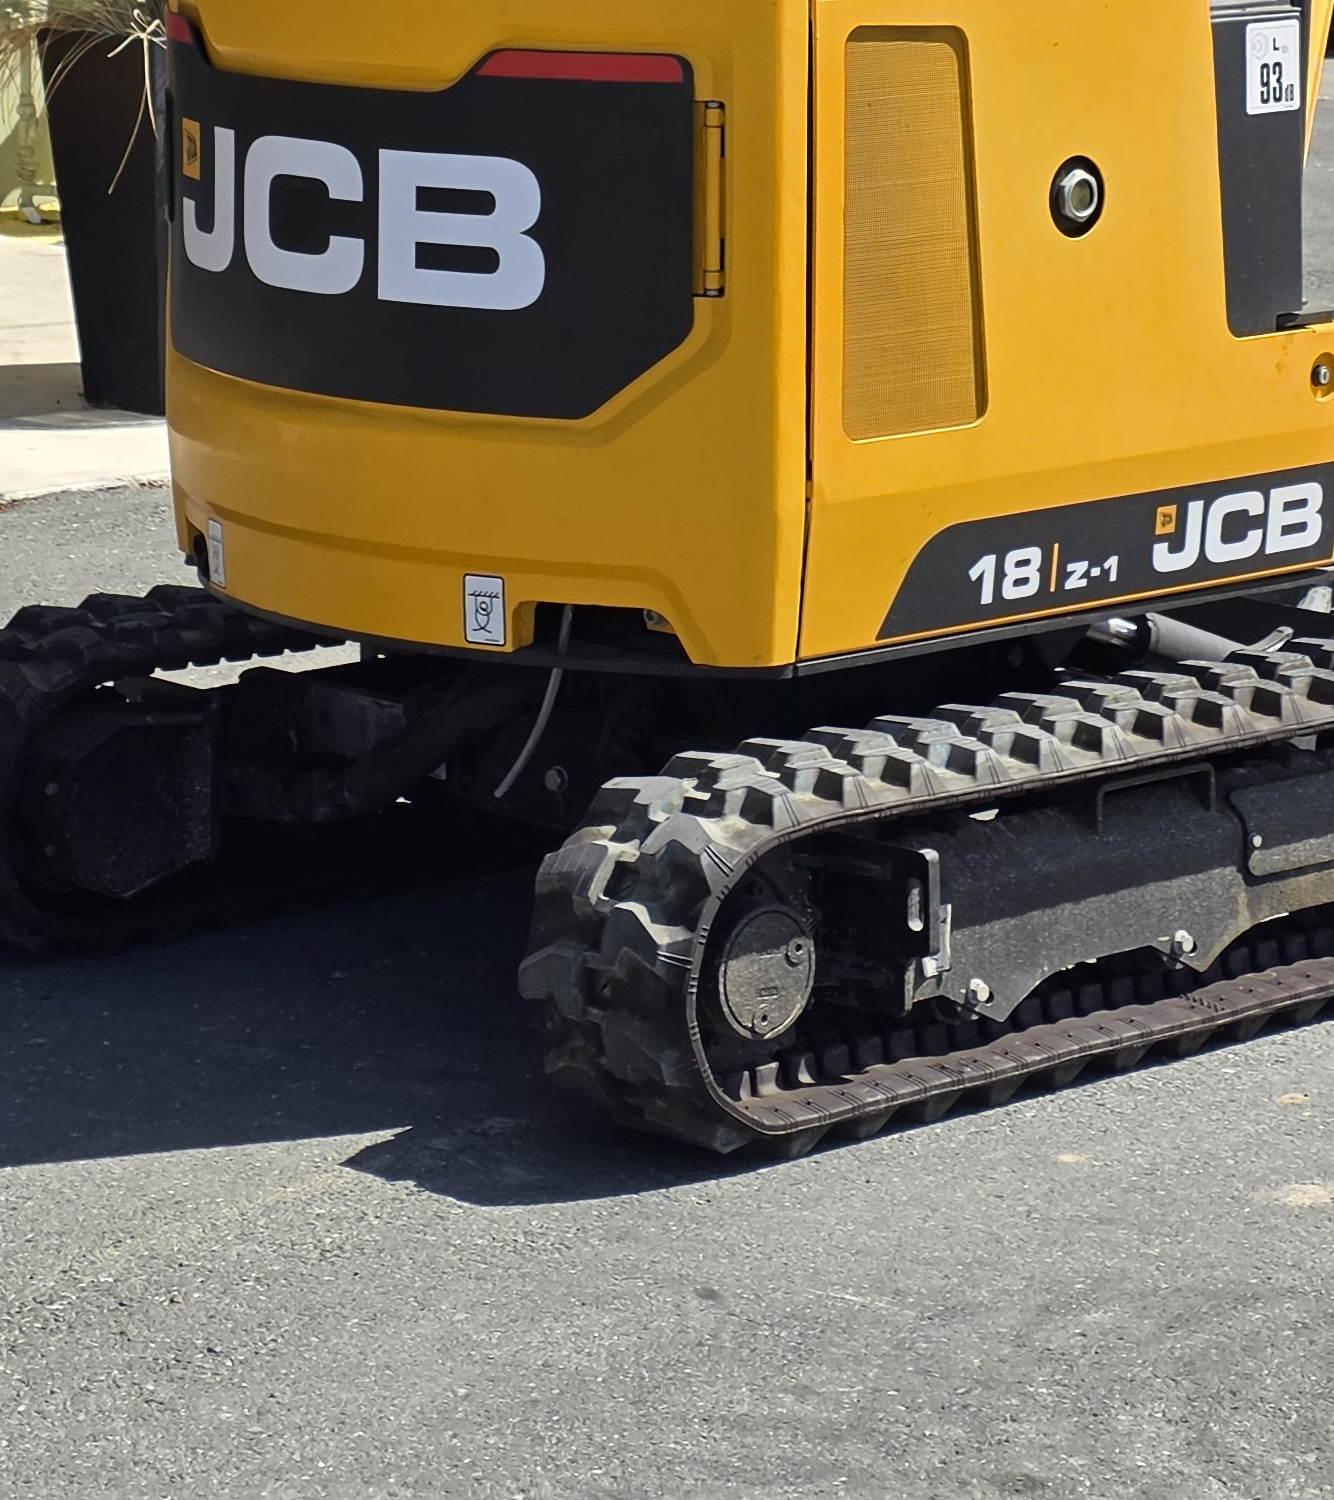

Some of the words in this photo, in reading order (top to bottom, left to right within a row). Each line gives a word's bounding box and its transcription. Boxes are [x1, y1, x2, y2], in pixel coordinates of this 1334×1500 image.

[1260, 61, 1283, 105] 93
[182, 125, 546, 311] JCB
[1152, 481, 1324, 574] JCB
